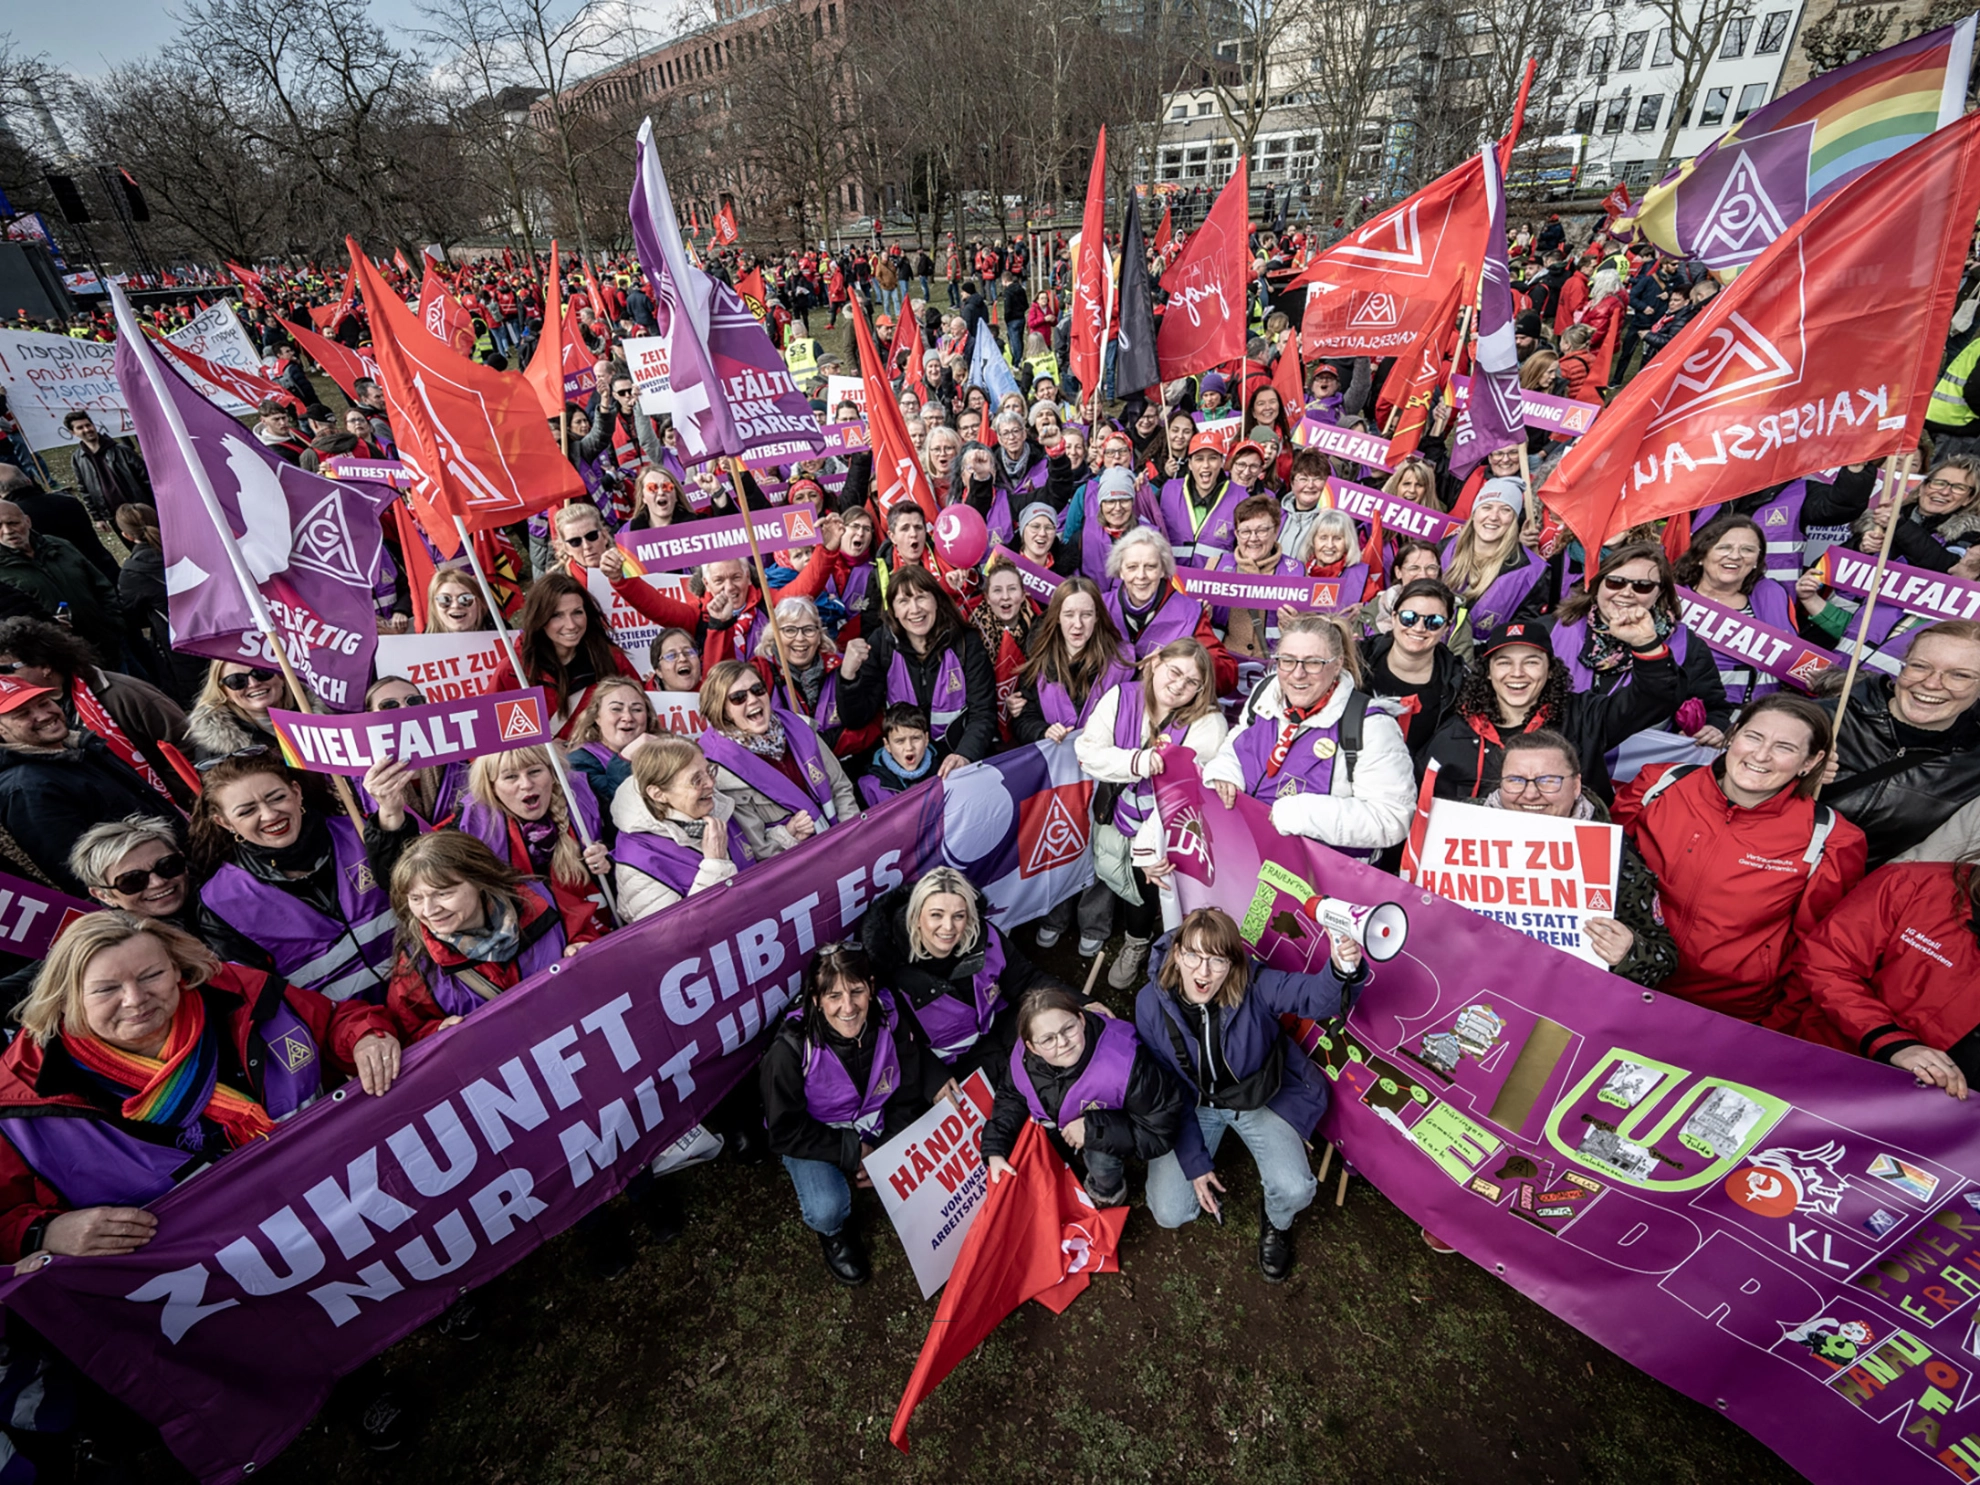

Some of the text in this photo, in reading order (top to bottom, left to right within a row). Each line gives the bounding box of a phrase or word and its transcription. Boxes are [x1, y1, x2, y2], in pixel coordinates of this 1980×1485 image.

[640, 348, 667, 365] ZEIT
[1185, 578, 1308, 602] MITBESTIMMUNG
[407, 650, 502, 685] ZEIT ZU
[289, 710, 478, 768] VIELFALT
[1445, 838, 1574, 871] ZEIT ZU
[1422, 870, 1577, 908] HANDELN
[1522, 912, 1578, 930] STATT
[1905, 926, 1941, 950] IG Metall
[1900, 934, 1953, 968] Kaiserslautern
[125, 850, 904, 1345] ZUKUNFT GIBT ES
[1439, 1104, 1484, 1139] Thüringen
[307, 965, 802, 1327] NUR MIT UN
[889, 1097, 979, 1201] HÄNDE
[1415, 1132, 1446, 1159] Stark
[1684, 1134, 1711, 1155] Fulda
[940, 1192, 963, 1218] VON
[1788, 1222, 1850, 1270] KL
[1857, 1210, 1980, 1299] POWER
